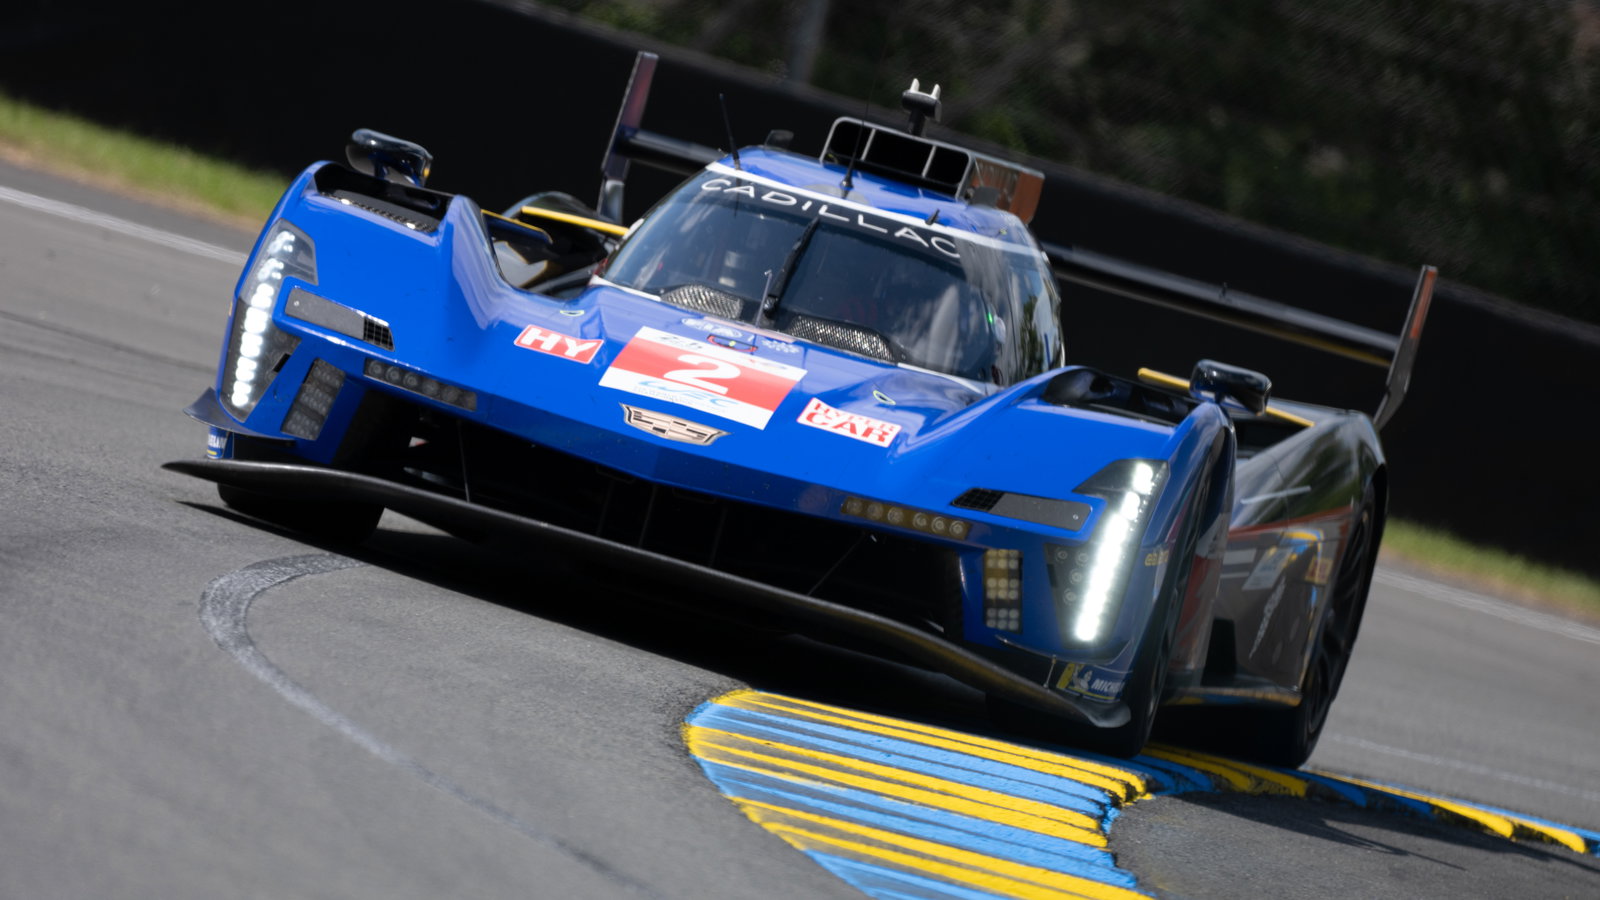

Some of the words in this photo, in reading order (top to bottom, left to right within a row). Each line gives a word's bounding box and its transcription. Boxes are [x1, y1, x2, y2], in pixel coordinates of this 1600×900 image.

[701, 178, 961, 259] CADILLAC
[520, 327, 600, 358] HY
[663, 354, 741, 395] 2
[806, 412, 889, 442] CAR
[814, 402, 896, 432] HYPER
